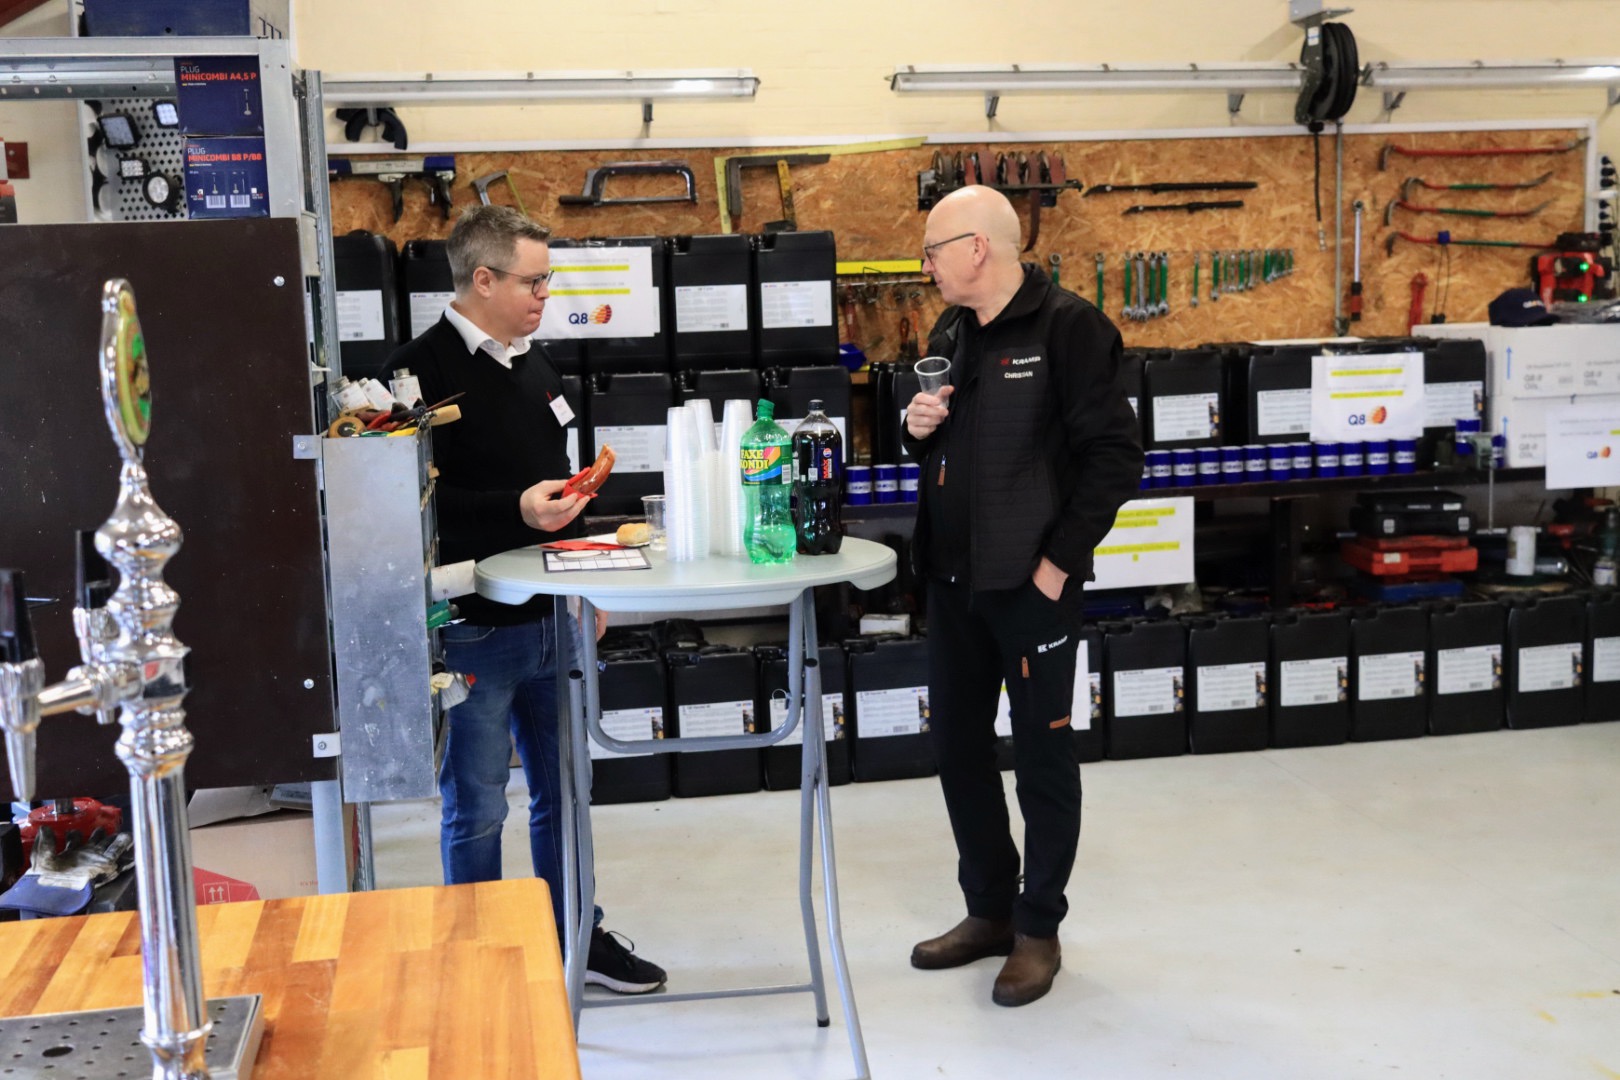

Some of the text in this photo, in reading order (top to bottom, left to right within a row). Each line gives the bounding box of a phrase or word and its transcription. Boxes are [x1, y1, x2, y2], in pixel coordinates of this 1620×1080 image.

[180, 65, 200, 74] PLUG
[180, 72, 228, 81] MINICOMBI
[250, 72, 257, 80] P
[187, 147, 206, 155] PLUG
[187, 153, 230, 162] MINICOMBI
[568, 312, 588, 325] Q8
[1012, 355, 1041, 366] KRAMP
[1348, 414, 1366, 426] Q8
